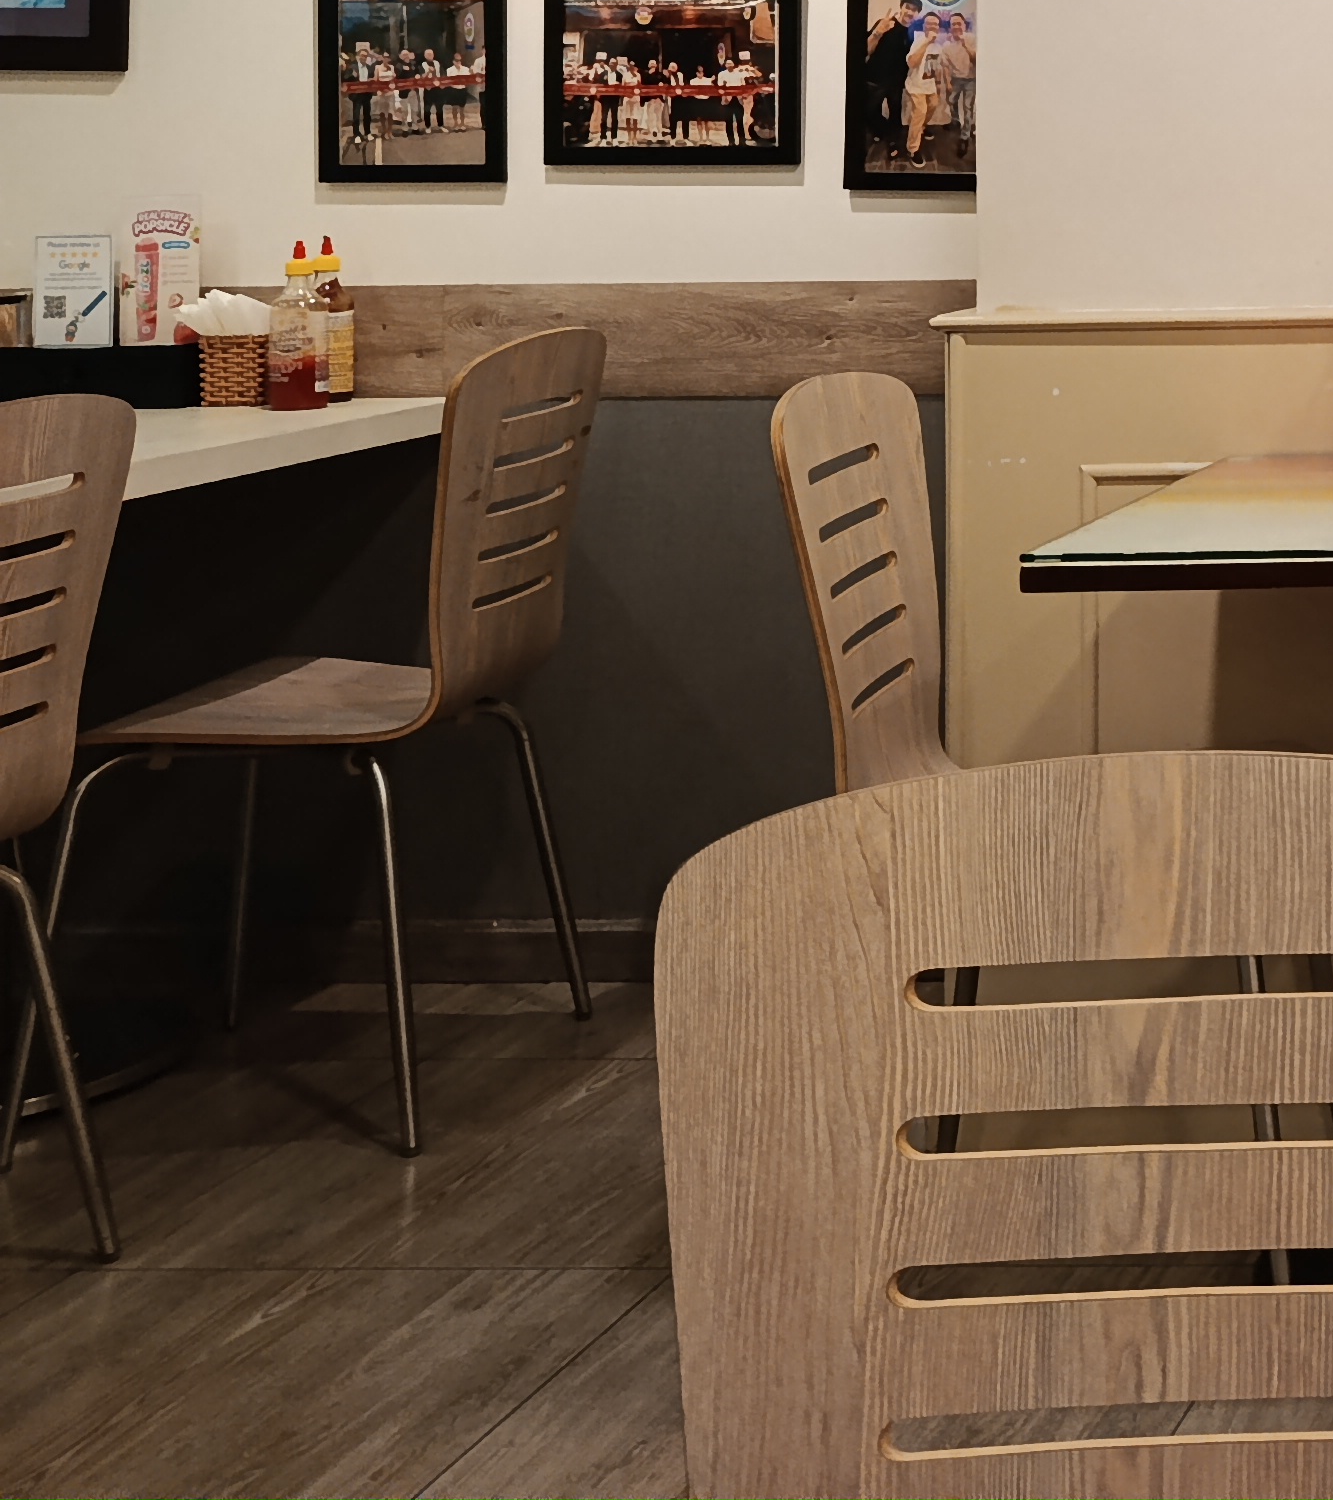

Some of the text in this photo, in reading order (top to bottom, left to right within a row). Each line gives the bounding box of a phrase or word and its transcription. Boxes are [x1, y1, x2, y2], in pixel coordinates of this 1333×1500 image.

[138, 211, 185, 222] REAL FRUIT
[134, 221, 189, 235] POPSICLE
[59, 260, 91, 271] Google
